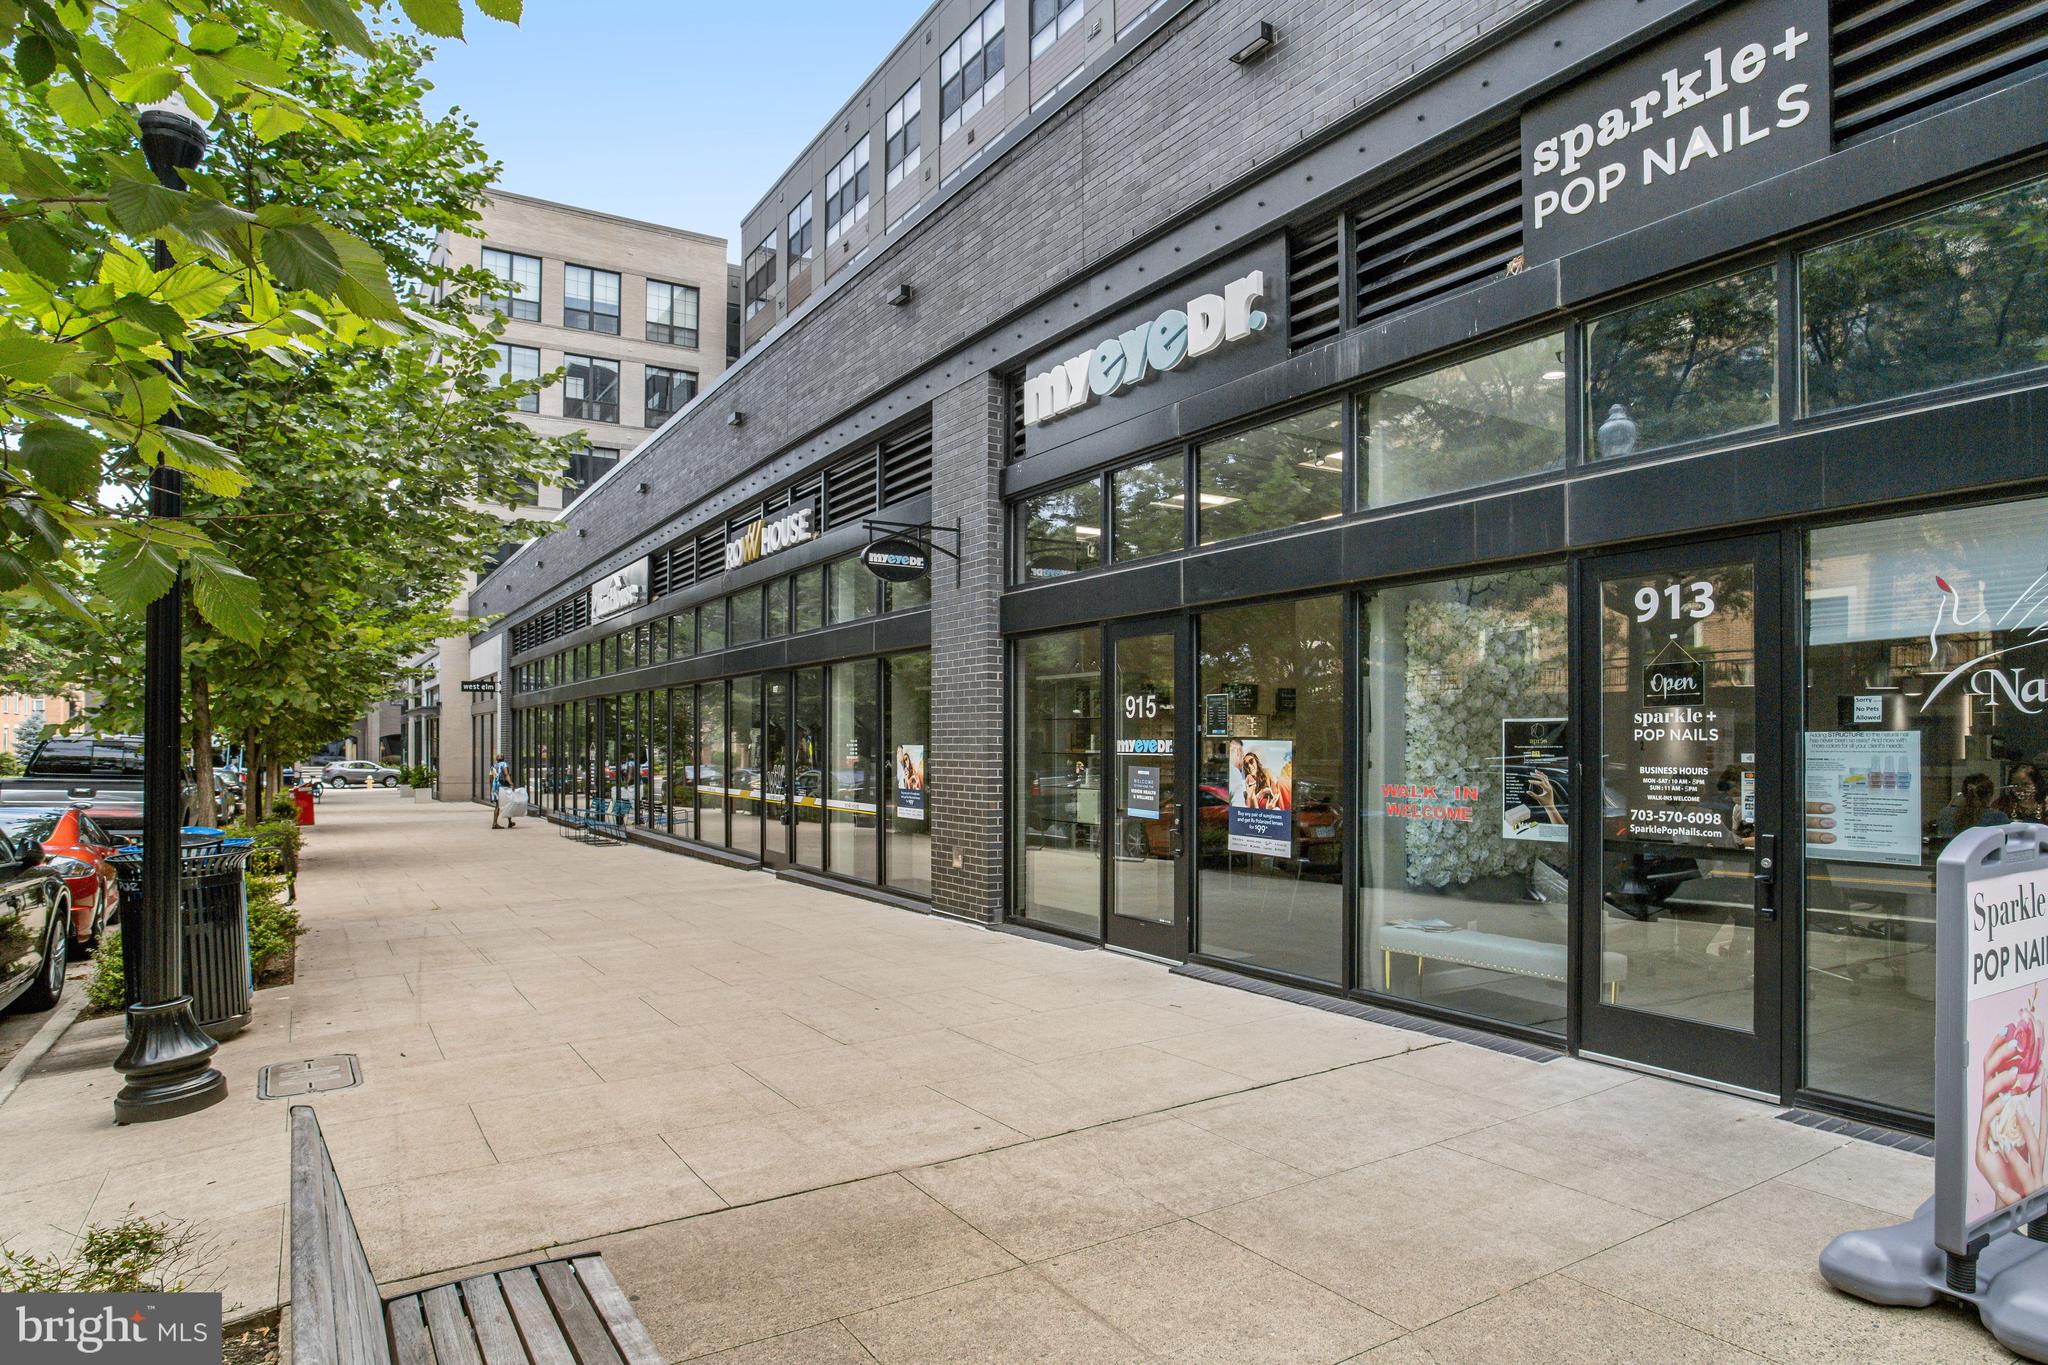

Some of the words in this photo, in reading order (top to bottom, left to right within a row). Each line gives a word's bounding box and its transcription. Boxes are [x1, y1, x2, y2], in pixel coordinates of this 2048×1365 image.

[1533, 26, 1808, 177] sparkle+
[1535, 162, 1626, 229] POP
[1643, 83, 1809, 185] NAILS
[761, 508, 811, 555] HOUSE
[1634, 581, 1715, 623] 913
[1650, 673, 1697, 700] Open
[1126, 695, 1156, 719] 915
[1634, 708, 1703, 726] sparkle
[1634, 729, 1665, 741] POP
[1670, 729, 1719, 741] NAILS
[1640, 766, 1677, 775] BUSINESS
[1679, 767, 1708, 775] HOURS
[1381, 783, 1438, 800] WALK
[1455, 785, 1478, 801] IN
[1386, 802, 1472, 822] WELCOME
[1630, 809, 1722, 825] 703-570-6098
[1630, 824, 1722, 838] SparklePopNails.com
[1974, 882, 2046, 942] Sparkle
[1974, 946, 2010, 985] POP
[2015, 935, 2048, 973] NAI
